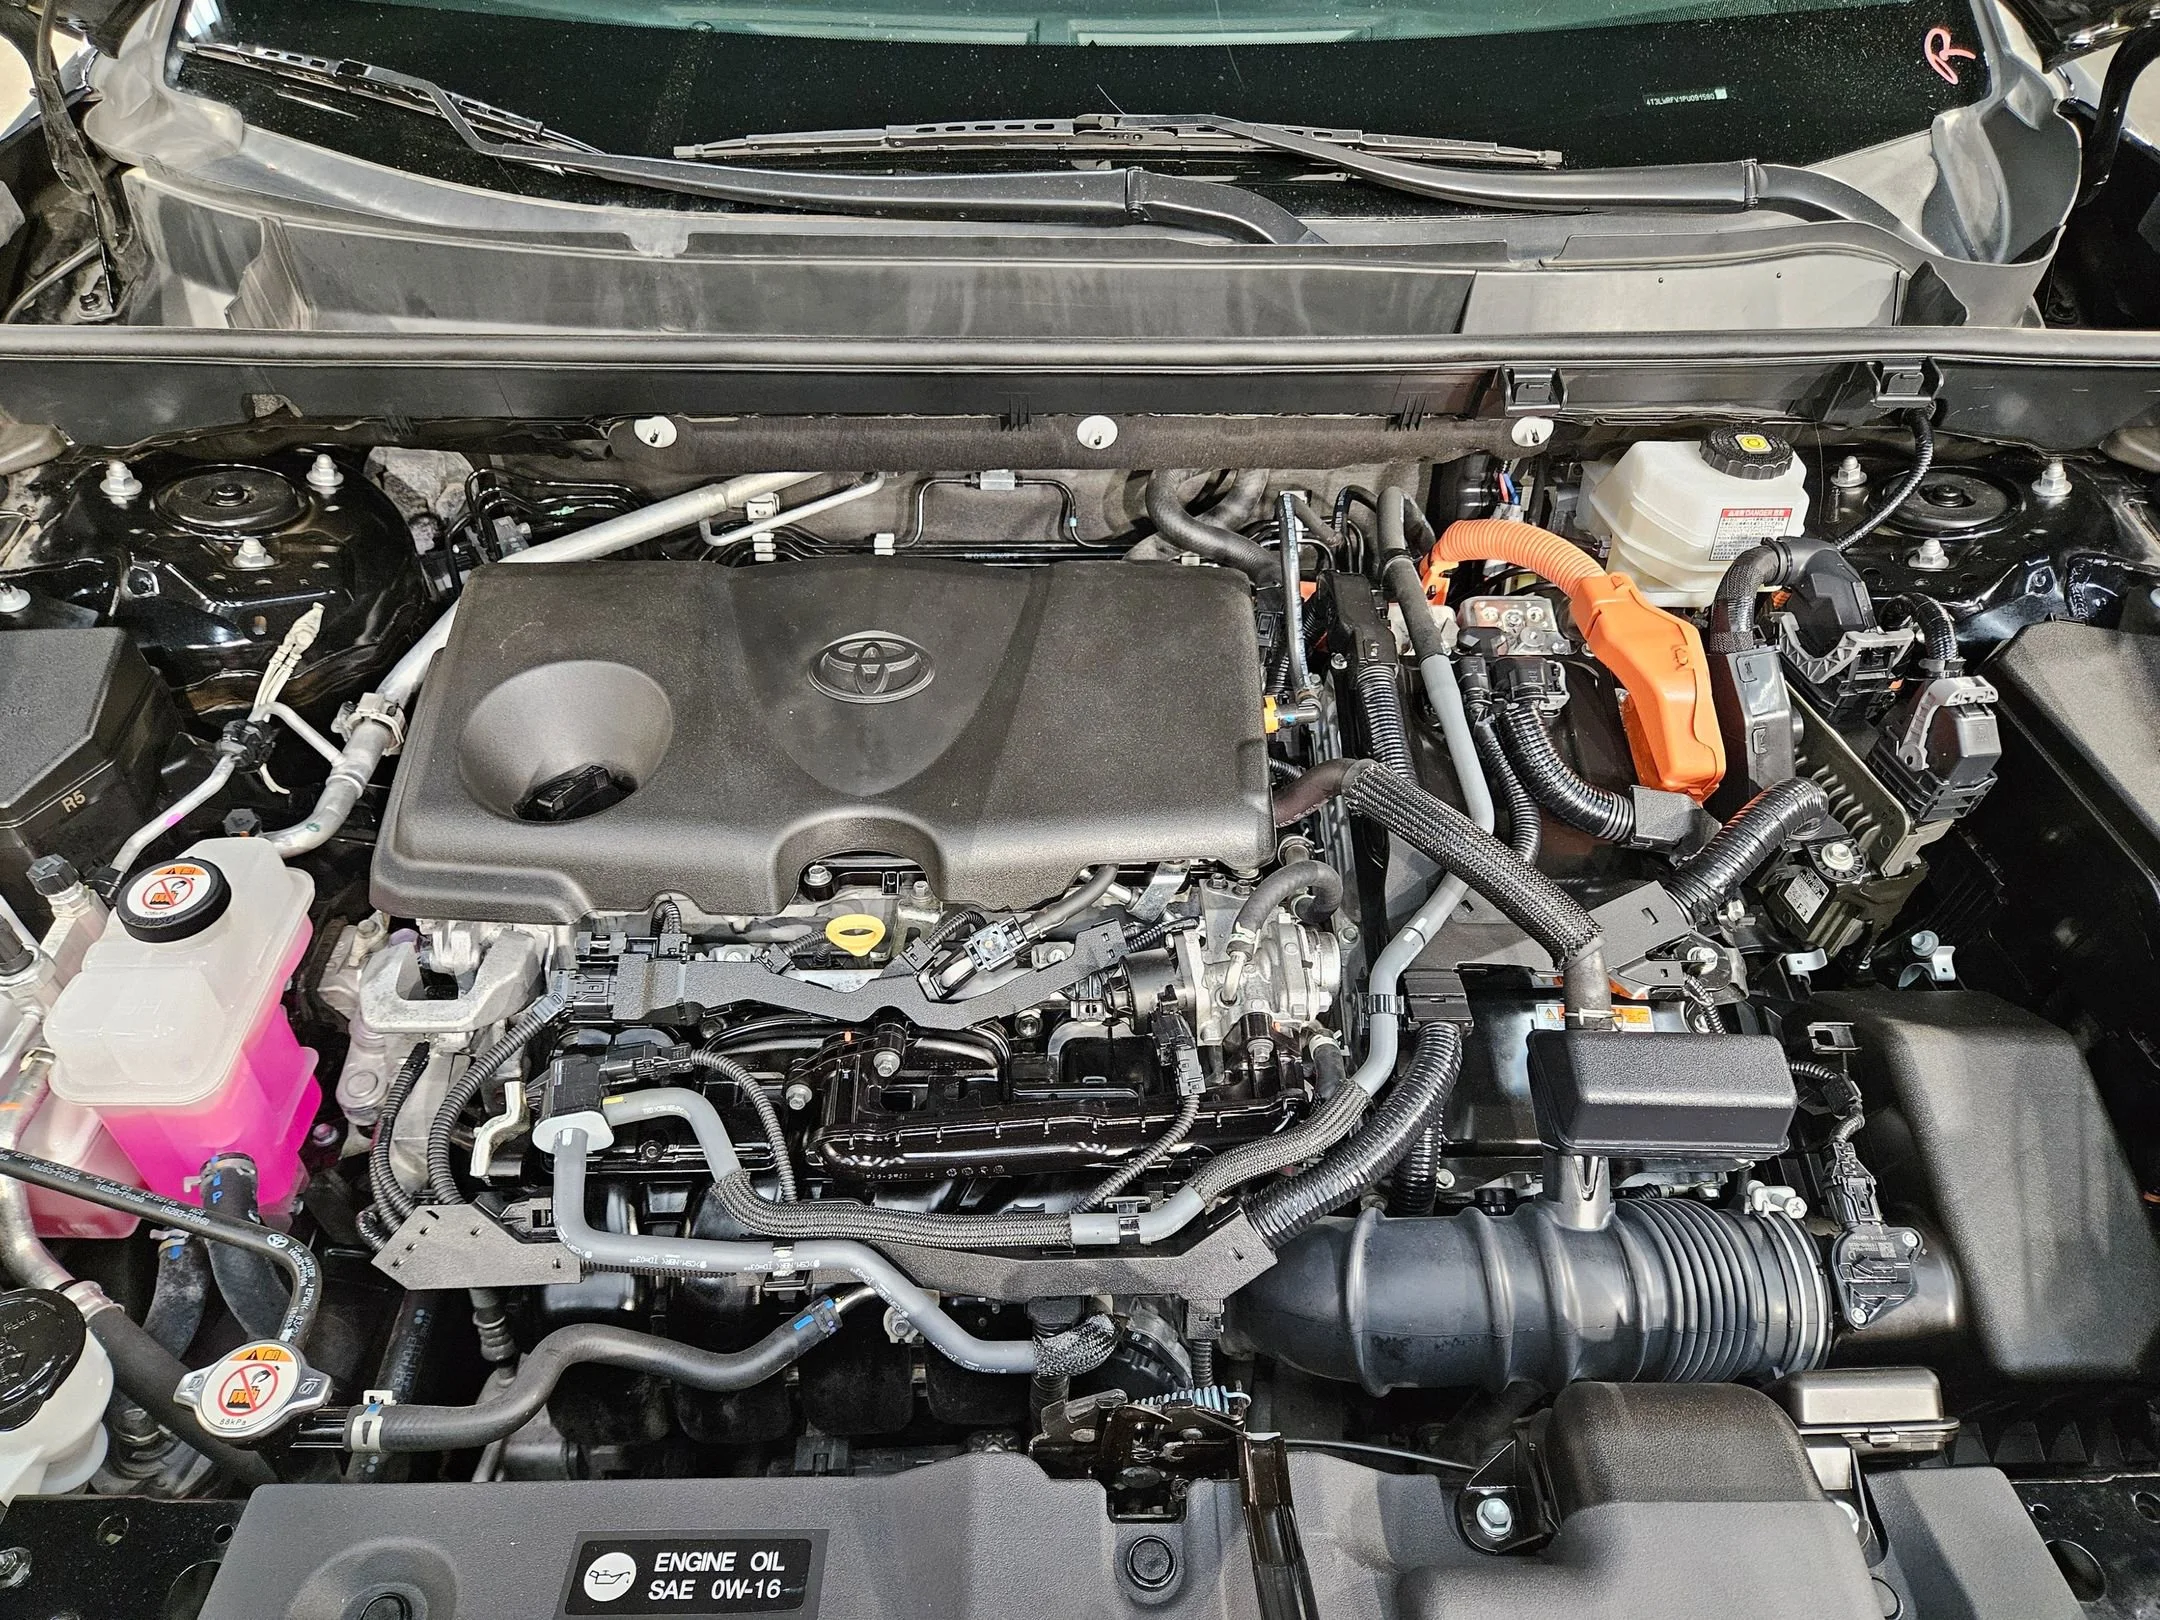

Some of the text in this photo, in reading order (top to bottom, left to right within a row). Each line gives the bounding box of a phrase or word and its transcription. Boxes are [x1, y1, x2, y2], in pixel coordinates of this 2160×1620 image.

[61, 790, 86, 813] R5
[653, 1551, 786, 1573] ENGINE OIL
[648, 1578, 782, 1601] SAE 0W-16
